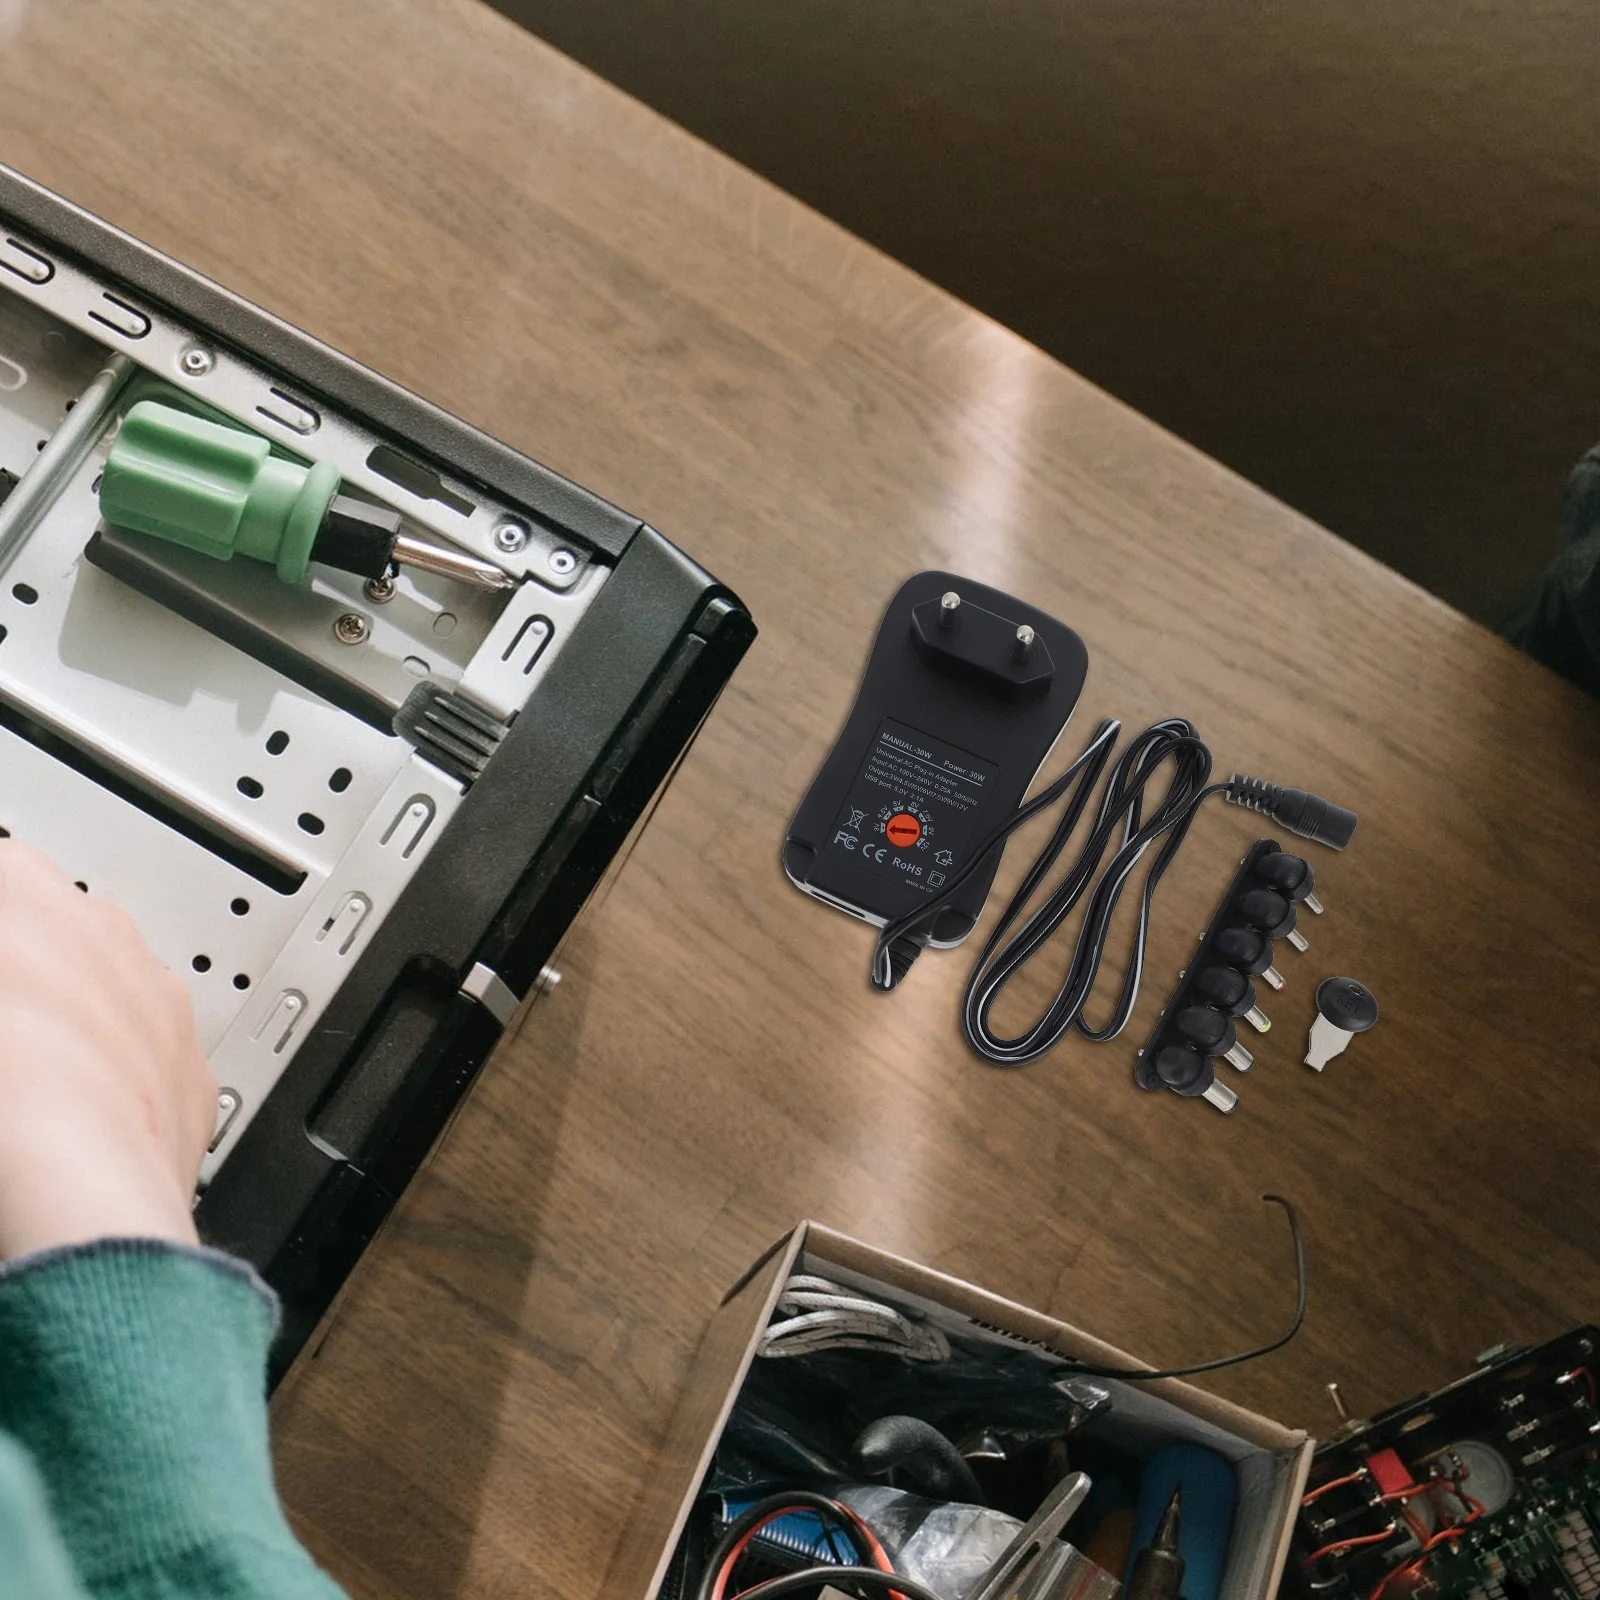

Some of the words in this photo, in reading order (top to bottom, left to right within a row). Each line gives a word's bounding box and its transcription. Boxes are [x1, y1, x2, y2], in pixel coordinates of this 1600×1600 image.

[876, 747, 903, 763] Universal
[903, 760, 913, 768] AC
[935, 773, 958, 788] Adapter
[881, 732, 932, 759] MANUAL-30W
[944, 760, 968, 775] Power:
[969, 771, 985, 782] 30W
[864, 773, 878, 783] USB
[894, 786, 908, 796] 5.0V
[910, 793, 924, 803] 2.1A
[862, 843, 887, 864] CE
[892, 857, 923, 876] RoHS
[1336, 993, 1367, 1014] KEY
